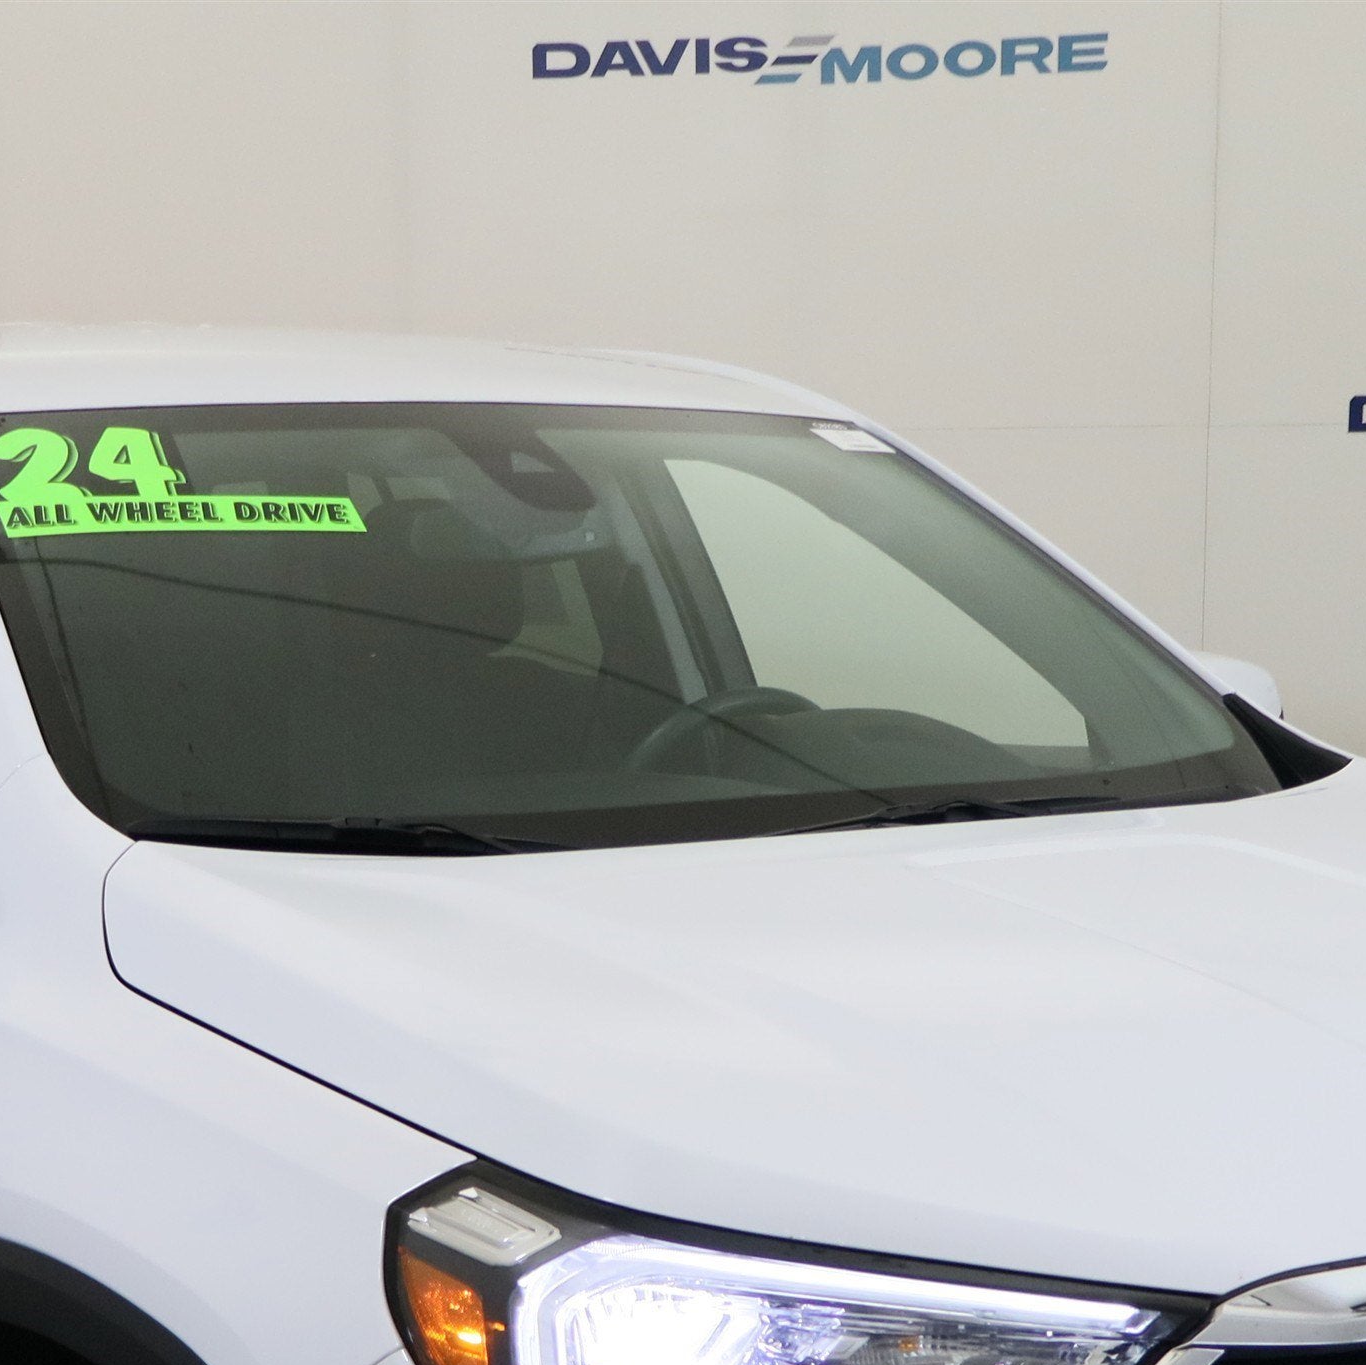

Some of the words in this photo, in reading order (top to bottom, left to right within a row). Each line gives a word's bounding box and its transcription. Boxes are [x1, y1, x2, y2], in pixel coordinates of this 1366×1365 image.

[532, 36, 768, 79] DAVIS
[820, 33, 1108, 84] MOORE
[5, 499, 75, 529] ALL
[88, 500, 226, 524] WHEEL
[235, 501, 351, 526] DRIVE
